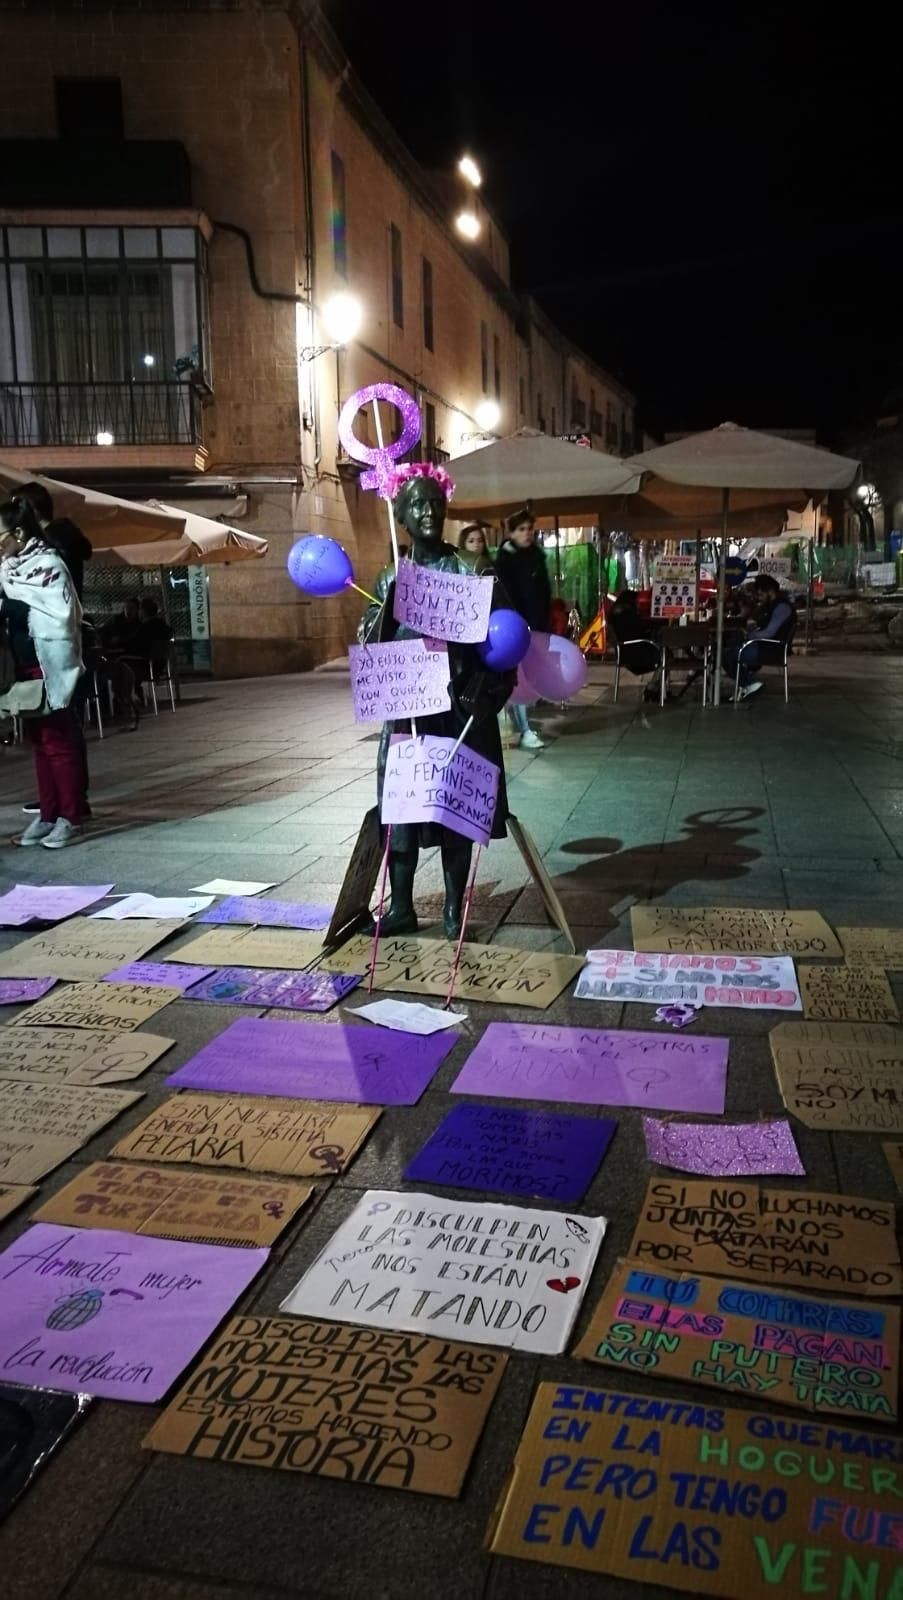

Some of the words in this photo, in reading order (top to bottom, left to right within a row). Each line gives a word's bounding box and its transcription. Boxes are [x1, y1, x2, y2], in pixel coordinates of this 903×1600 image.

[194, 571, 206, 624] PANDORA
[400, 584, 479, 621] JUNTAS
[416, 573, 472, 597] ESTAMOS
[406, 608, 423, 626] EN
[430, 616, 465, 634] ESTO
[360, 703, 377, 717] ME
[386, 698, 442, 713] DESVISTO
[398, 744, 416, 760] LO
[414, 762, 497, 810] FEMINISMO
[426, 789, 492, 827] IGNORANCIA
[384, 941, 422, 953] NO
[388, 954, 418, 965] LO
[511, 1029, 561, 1042] SIN
[580, 1033, 713, 1054] NOSOTRAS
[160, 1100, 226, 1120] SIN
[796, 1083, 865, 1100] SOY
[796, 1099, 836, 1110] NO
[130, 1133, 244, 1163] PETARIA
[439, 1160, 569, 1197] MORIMOS?
[393, 1206, 552, 1242] DISCULPEN
[646, 1204, 757, 1228] JUNTAS
[776, 1218, 844, 1240] NOS
[652, 1184, 687, 1208] SI
[710, 1189, 746, 1210] NO
[760, 1192, 890, 1227] LUCHAMOS
[358, 1224, 418, 1248] LAS
[426, 1232, 577, 1270] MOLESTIAS
[372, 1253, 423, 1275] NOS
[636, 1240, 694, 1263] POR
[726, 1250, 894, 1287] SEPARADO
[140, 1272, 202, 1300] mujer
[329, 1278, 548, 1334] MATANDO
[209, 1339, 419, 1385] MOLESTIAS
[423, 1368, 486, 1395] LAS
[232, 1320, 429, 1359] DISCULPEN
[432, 1344, 498, 1376] LAS
[609, 1322, 680, 1354] SIN
[710, 1340, 882, 1389] PUTERO
[186, 1364, 437, 1423] MUJERES
[597, 1342, 660, 1369] NO
[694, 1362, 783, 1392] HAY
[792, 1382, 893, 1416] TRATA
[178, 1397, 305, 1426] ESTAMOS
[320, 1410, 453, 1452] HACIENDO
[543, 1416, 592, 1443] EN
[612, 1425, 662, 1457] LA
[552, 1386, 726, 1433] INTENTAS
[746, 1414, 903, 1463] QUEMAR
[185, 1415, 416, 1487] HISTORIA
[539, 1455, 659, 1500] PERO
[670, 1472, 788, 1523] TENGO
[522, 1504, 606, 1550] EN
[628, 1514, 722, 1571] LAS
